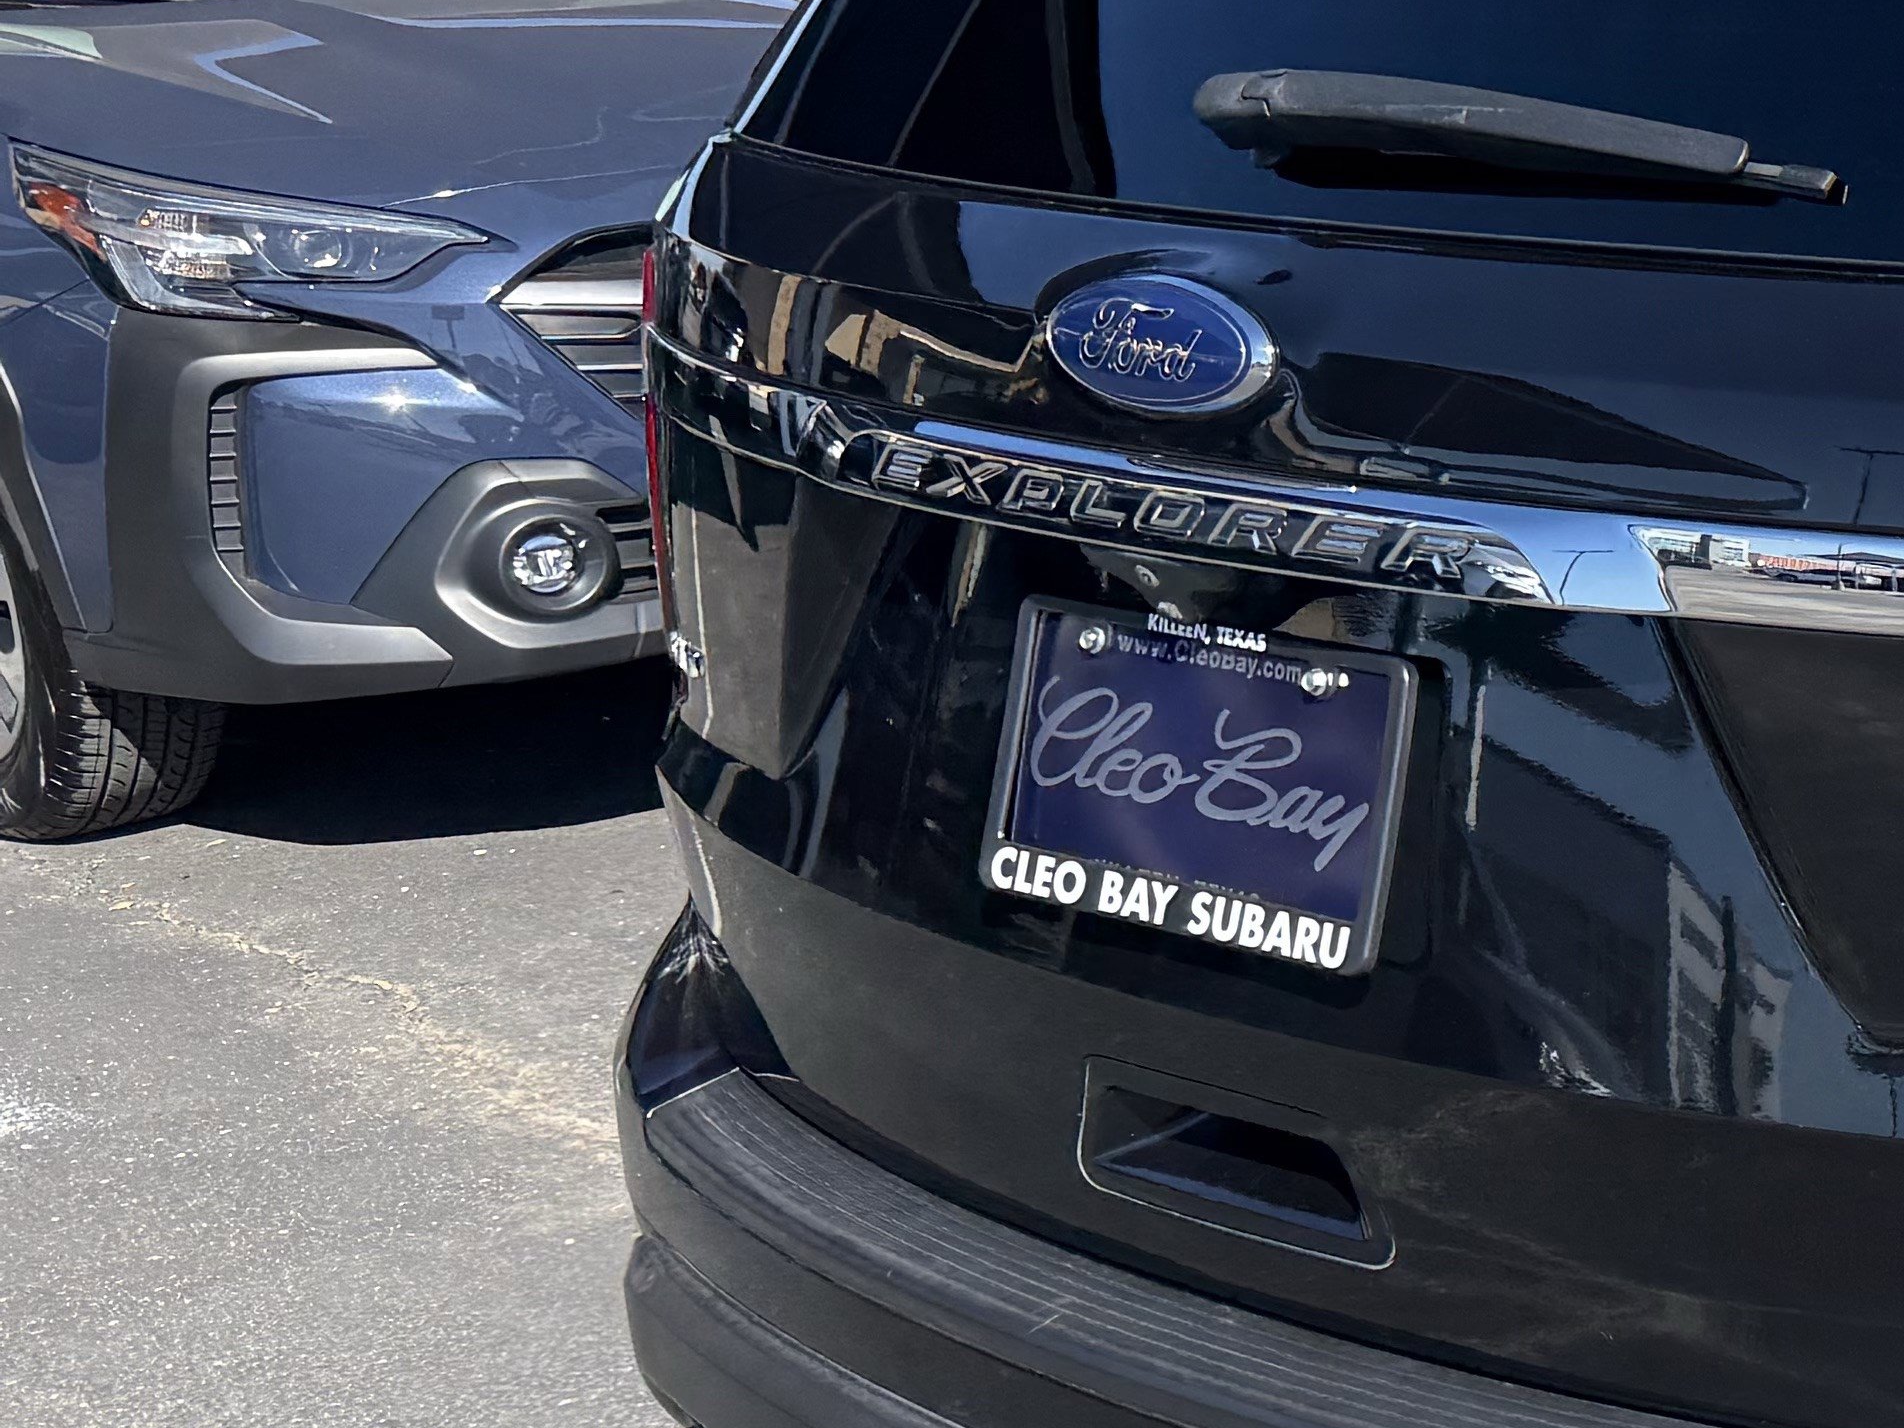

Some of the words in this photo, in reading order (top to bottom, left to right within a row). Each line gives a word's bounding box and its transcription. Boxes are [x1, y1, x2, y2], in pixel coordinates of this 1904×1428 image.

[1079, 296, 1203, 382] Ford
[870, 436, 1477, 580] EXPLORER
[1216, 626, 1268, 653] TEXAS
[1030, 675, 1200, 804] Cleo
[1194, 708, 1370, 873] Bay
[990, 845, 1087, 905] CLEO
[1097, 870, 1179, 926] BAY
[1187, 891, 1351, 969] SUBARU
